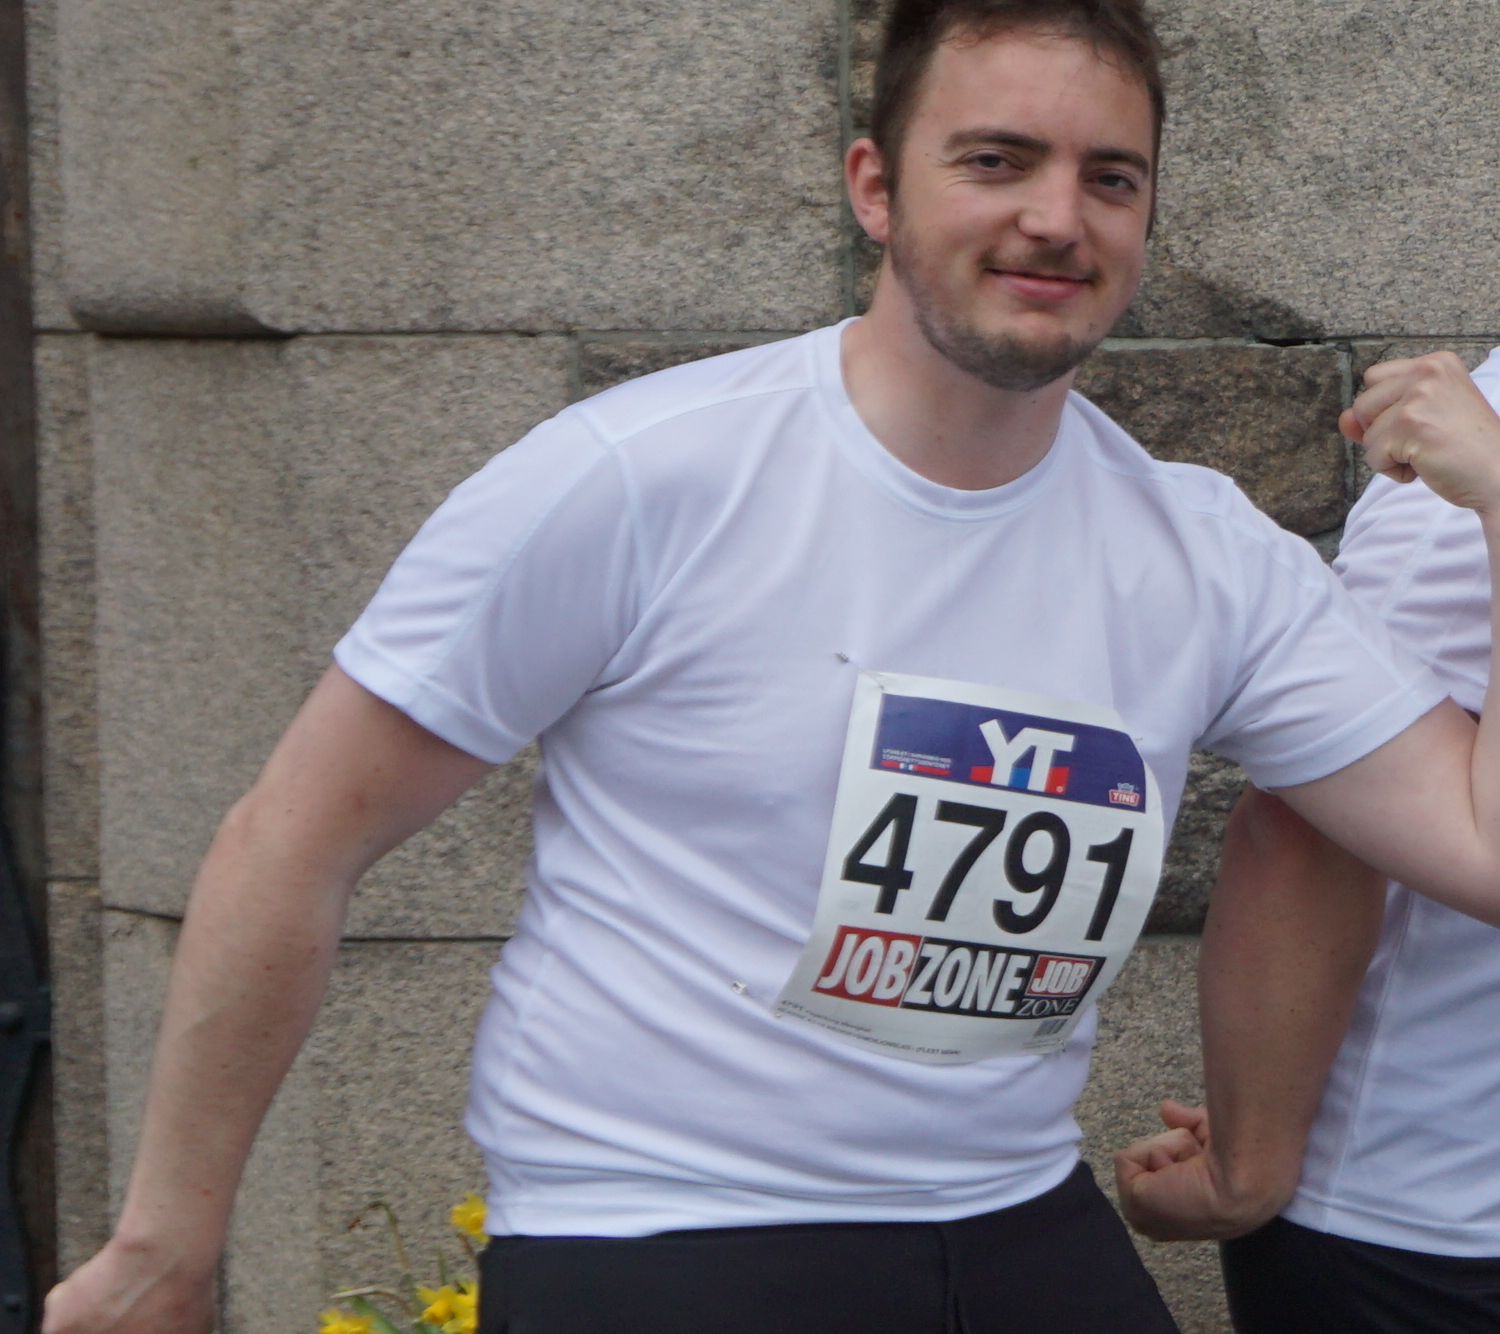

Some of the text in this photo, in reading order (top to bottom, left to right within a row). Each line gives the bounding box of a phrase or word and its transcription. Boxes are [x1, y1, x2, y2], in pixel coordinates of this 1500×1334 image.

[979, 718, 1077, 793] YT
[1112, 791, 1138, 805] TINE
[840, 793, 1135, 941] 4791
[1033, 958, 1088, 994] JOB
[1016, 997, 1079, 1018] ZONE
